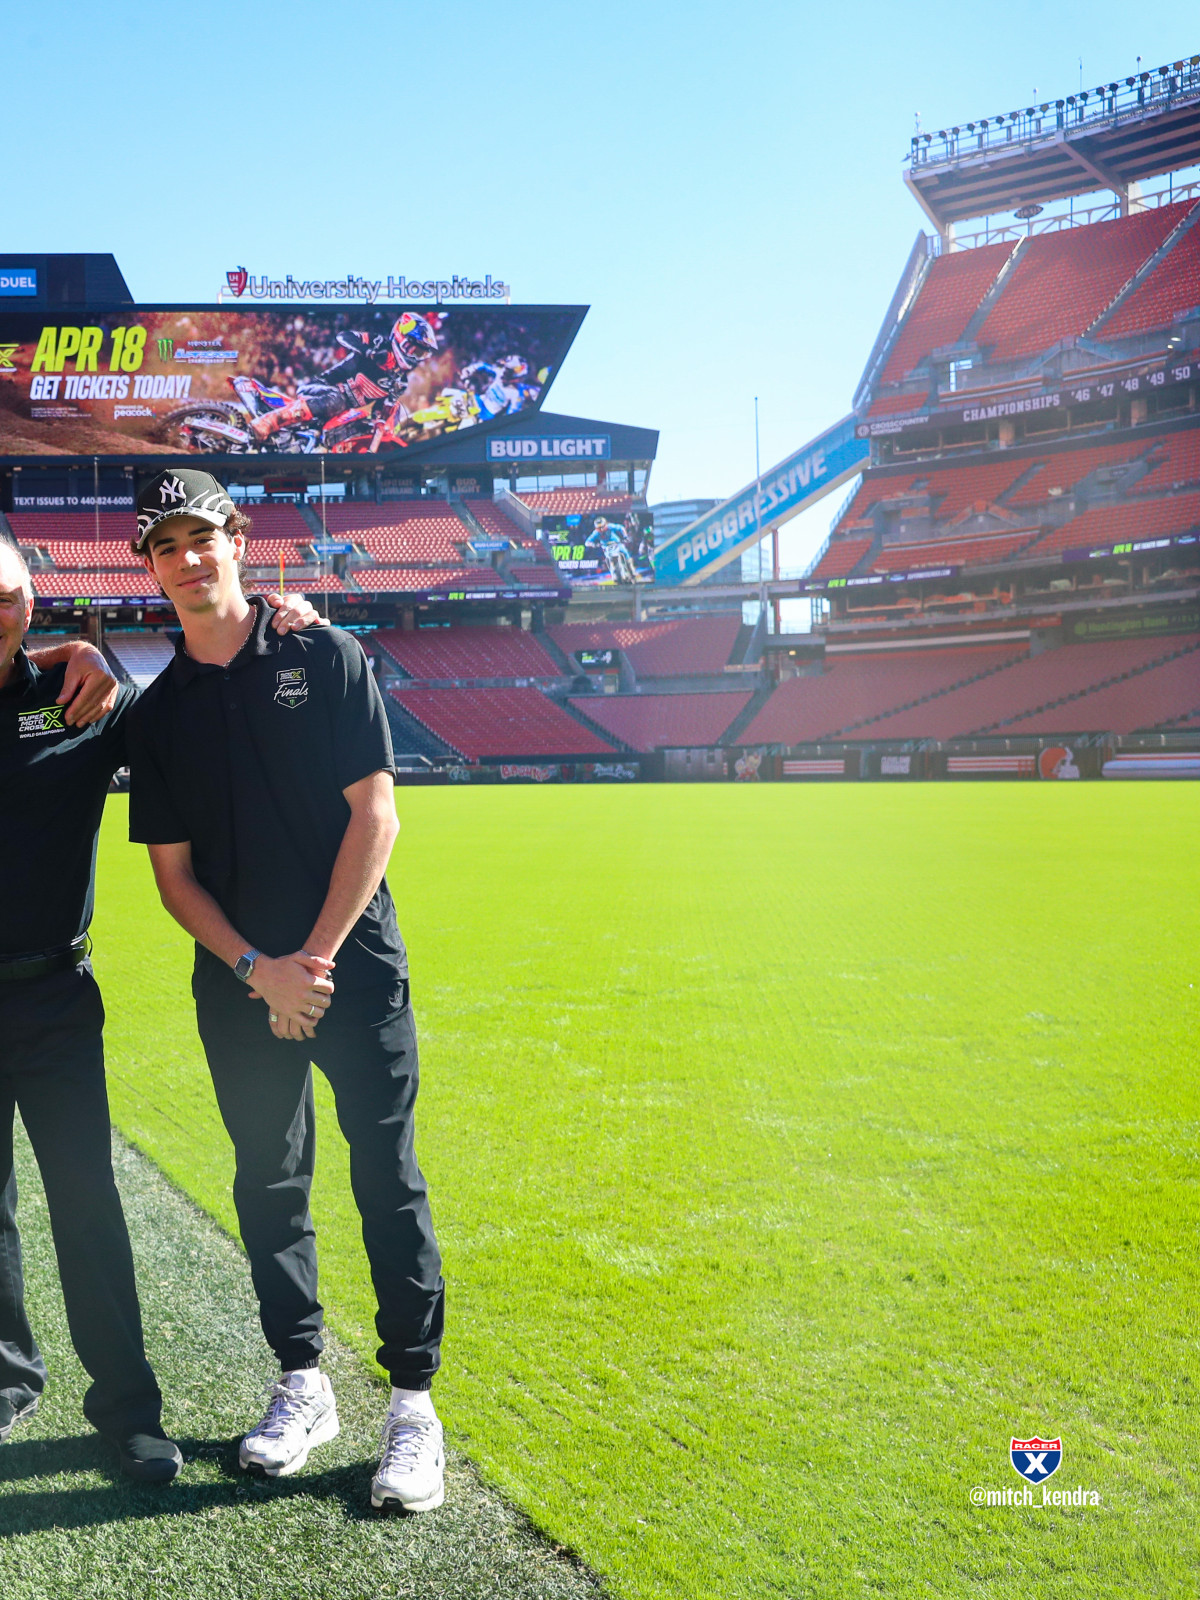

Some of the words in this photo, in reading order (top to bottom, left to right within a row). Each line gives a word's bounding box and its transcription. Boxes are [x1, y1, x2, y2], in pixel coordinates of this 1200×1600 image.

[250, 275, 381, 302] University
[388, 275, 504, 302] Hospitals
[30, 326, 104, 372] APR
[108, 326, 148, 372] 18
[30, 375, 62, 400] GET
[64, 375, 131, 399] TICKETS
[133, 374, 192, 399] TODAY!
[963, 394, 1060, 422] CHAMPIONSHIPS
[1071, 388, 1090, 402] '46
[1097, 383, 1115, 397] '47
[1121, 378, 1139, 392] '48
[1146, 372, 1165, 386] '49
[1171, 366, 1190, 380] '50
[114, 407, 153, 420] peacock
[870, 416, 929, 430] CROSSCOUNTRY
[491, 441, 538, 457] BUD
[541, 439, 606, 456] LIGHT
[159, 475, 187, 504] NY
[14, 497, 35, 505] TEXT
[36, 497, 64, 505] ISSUES
[66, 497, 79, 505] TO
[80, 496, 133, 505] 440-824-6000
[677, 448, 827, 572] PROGRESSIVE
[572, 545, 585, 561] 18
[1112, 544, 1125, 554] APR
[827, 579, 840, 588] APR
[448, 592, 458, 600] APR
[1088, 620, 1142, 632] Huntington
[1143, 617, 1169, 628] Bank
[273, 682, 309, 701] Finals
[18, 714, 45, 722] SUPER
[20, 719, 44, 727] MOTO
[18, 724, 45, 732] CROSS
[35, 728, 66, 737] CHAMPIONSHIP
